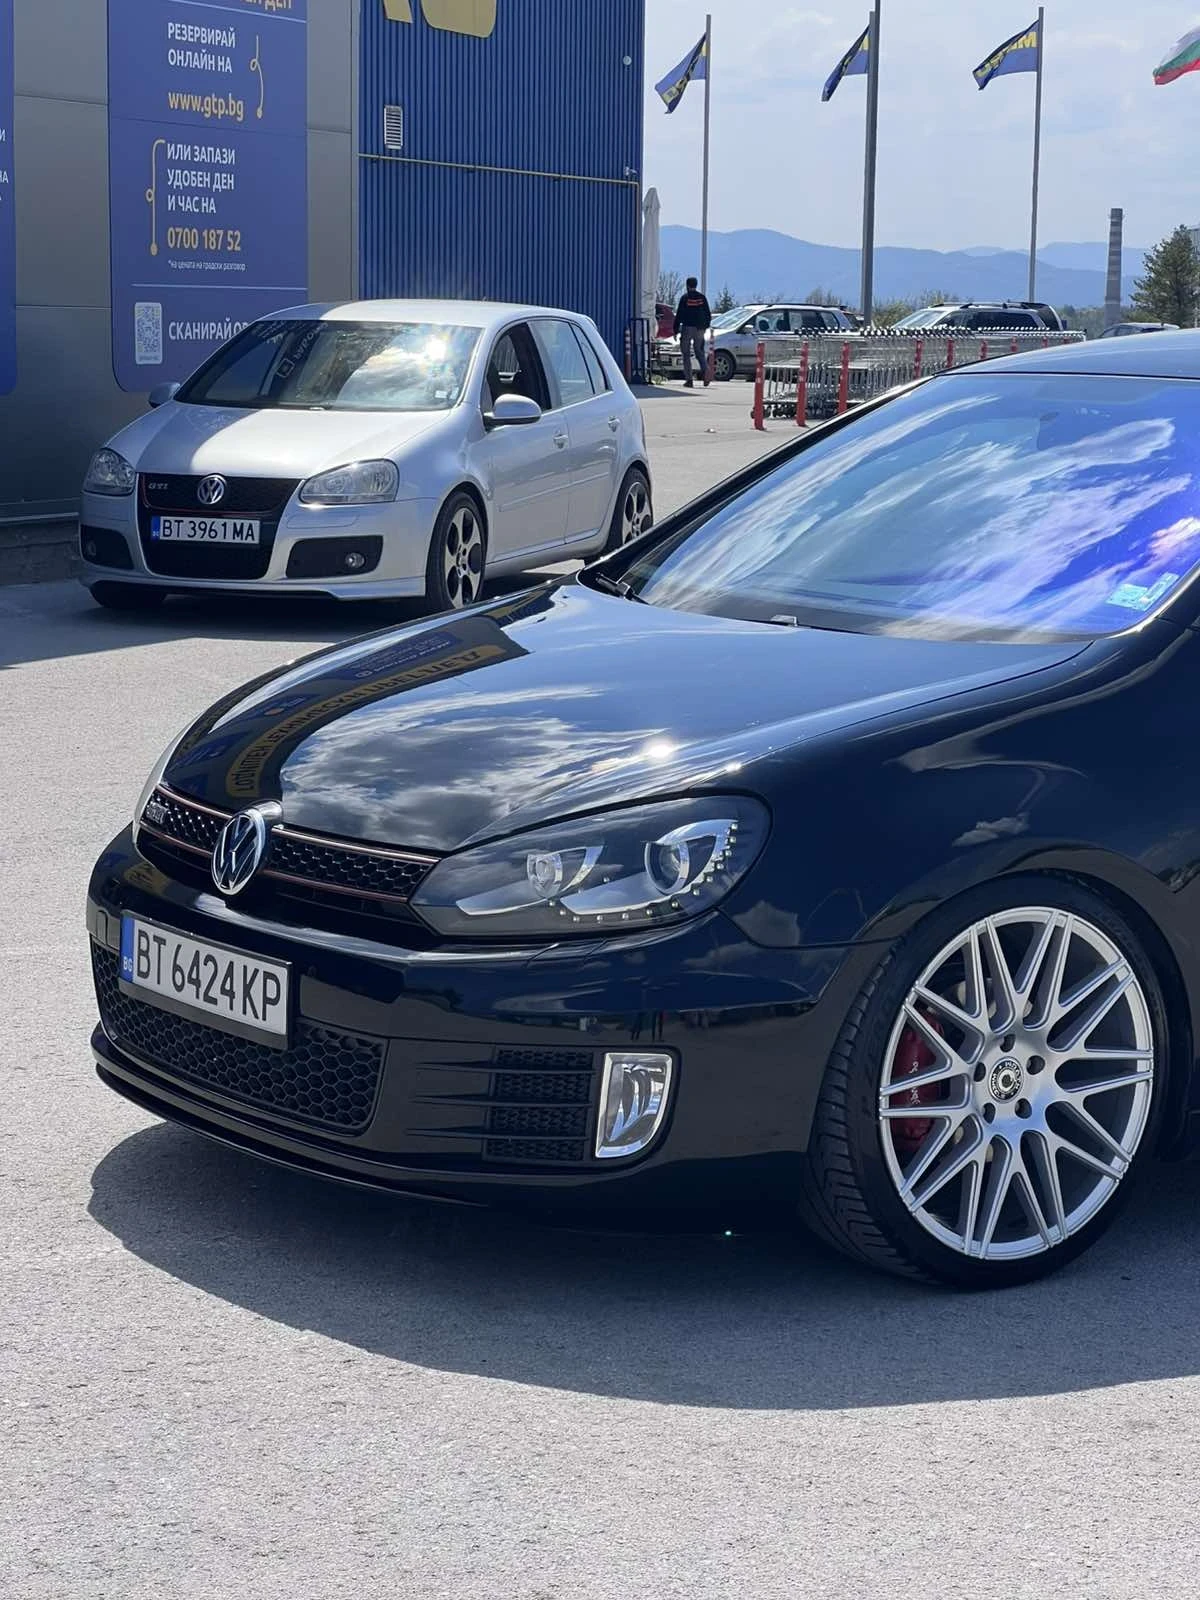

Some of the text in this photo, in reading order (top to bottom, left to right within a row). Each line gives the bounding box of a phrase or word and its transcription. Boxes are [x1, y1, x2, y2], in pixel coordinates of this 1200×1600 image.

[168, 22, 236, 48] РЕЗЕРВИРАЙ
[168, 48, 232, 73] ОНЛАЙН НА
[168, 92, 244, 121] www.gtp.bg
[167, 143, 235, 165] ИЛИ ЗАПАЗИ
[167, 169, 234, 192] УДОБЕН ДЕН
[168, 195, 216, 213] И ЧАС НА
[167, 227, 241, 251] 0700 187 52
[168, 317, 231, 340] СКАНИРАЙ
[162, 520, 255, 541] BT 3961 MA
[122, 956, 133, 972] BG
[136, 929, 281, 1021] BT 6424 KP
